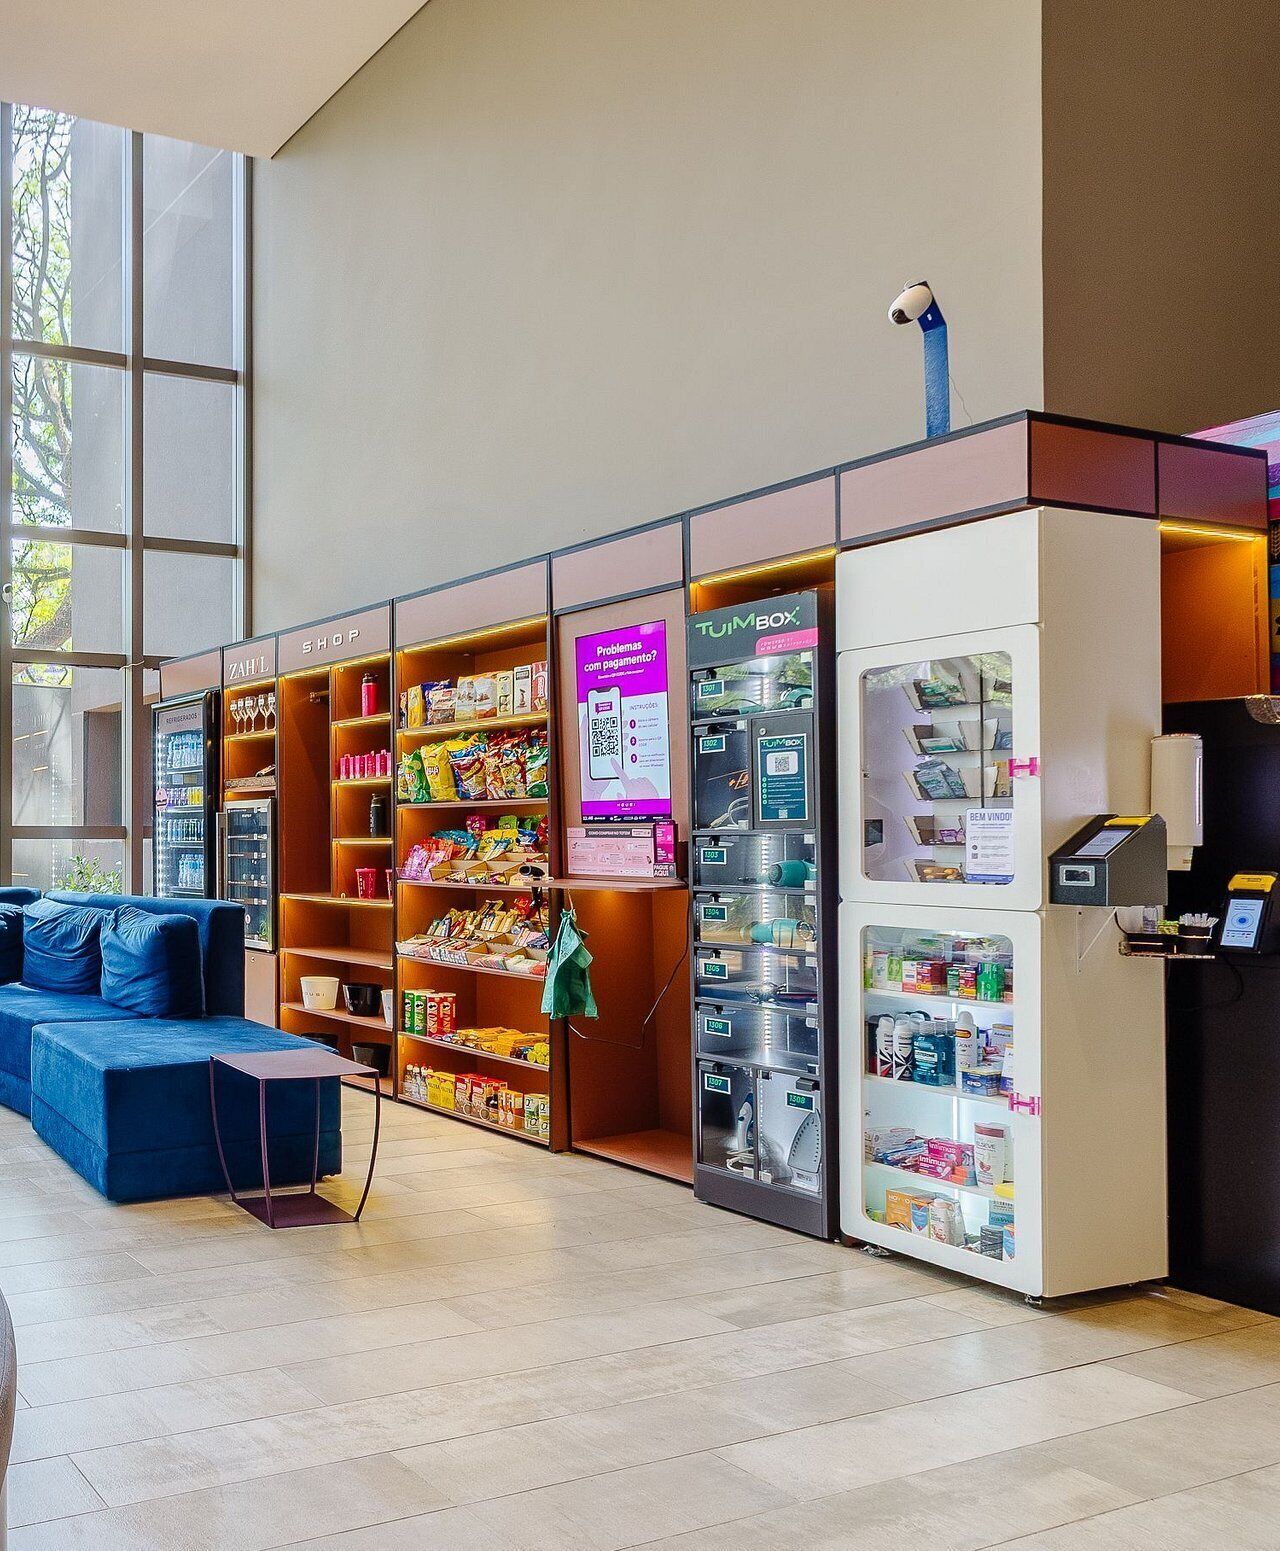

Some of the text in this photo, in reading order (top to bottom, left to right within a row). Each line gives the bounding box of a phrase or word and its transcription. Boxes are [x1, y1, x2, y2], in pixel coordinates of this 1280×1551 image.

[302, 629, 360, 654] SHOP
[596, 641, 642, 657] Problemas
[584, 650, 657, 672] com pagamento?
[166, 712, 197, 724] REFRIGERADOS
[703, 739, 718, 747] 1302
[970, 812, 986, 822] BEM
[705, 908, 719, 916] 1304
[706, 964, 720, 973] 1305
[708, 1077, 722, 1086] 1307
[929, 1142, 957, 1155] Intimus
[919, 1156, 947, 1168] Intimus
